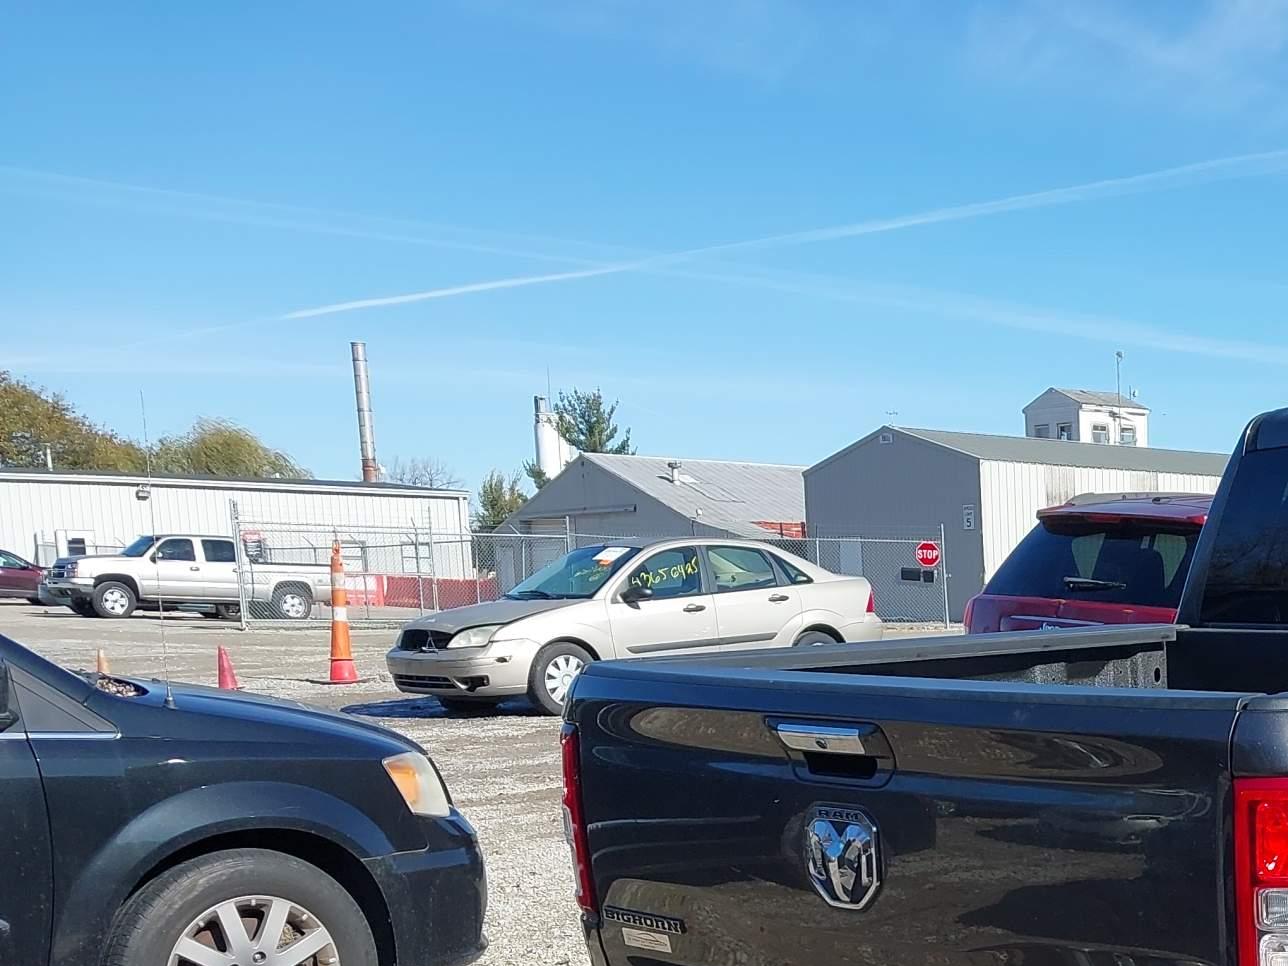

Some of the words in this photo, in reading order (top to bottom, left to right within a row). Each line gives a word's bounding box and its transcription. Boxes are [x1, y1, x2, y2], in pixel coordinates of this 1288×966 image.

[966, 517, 973, 528] 5
[917, 549, 939, 560] STOP
[817, 808, 860, 821] RAM
